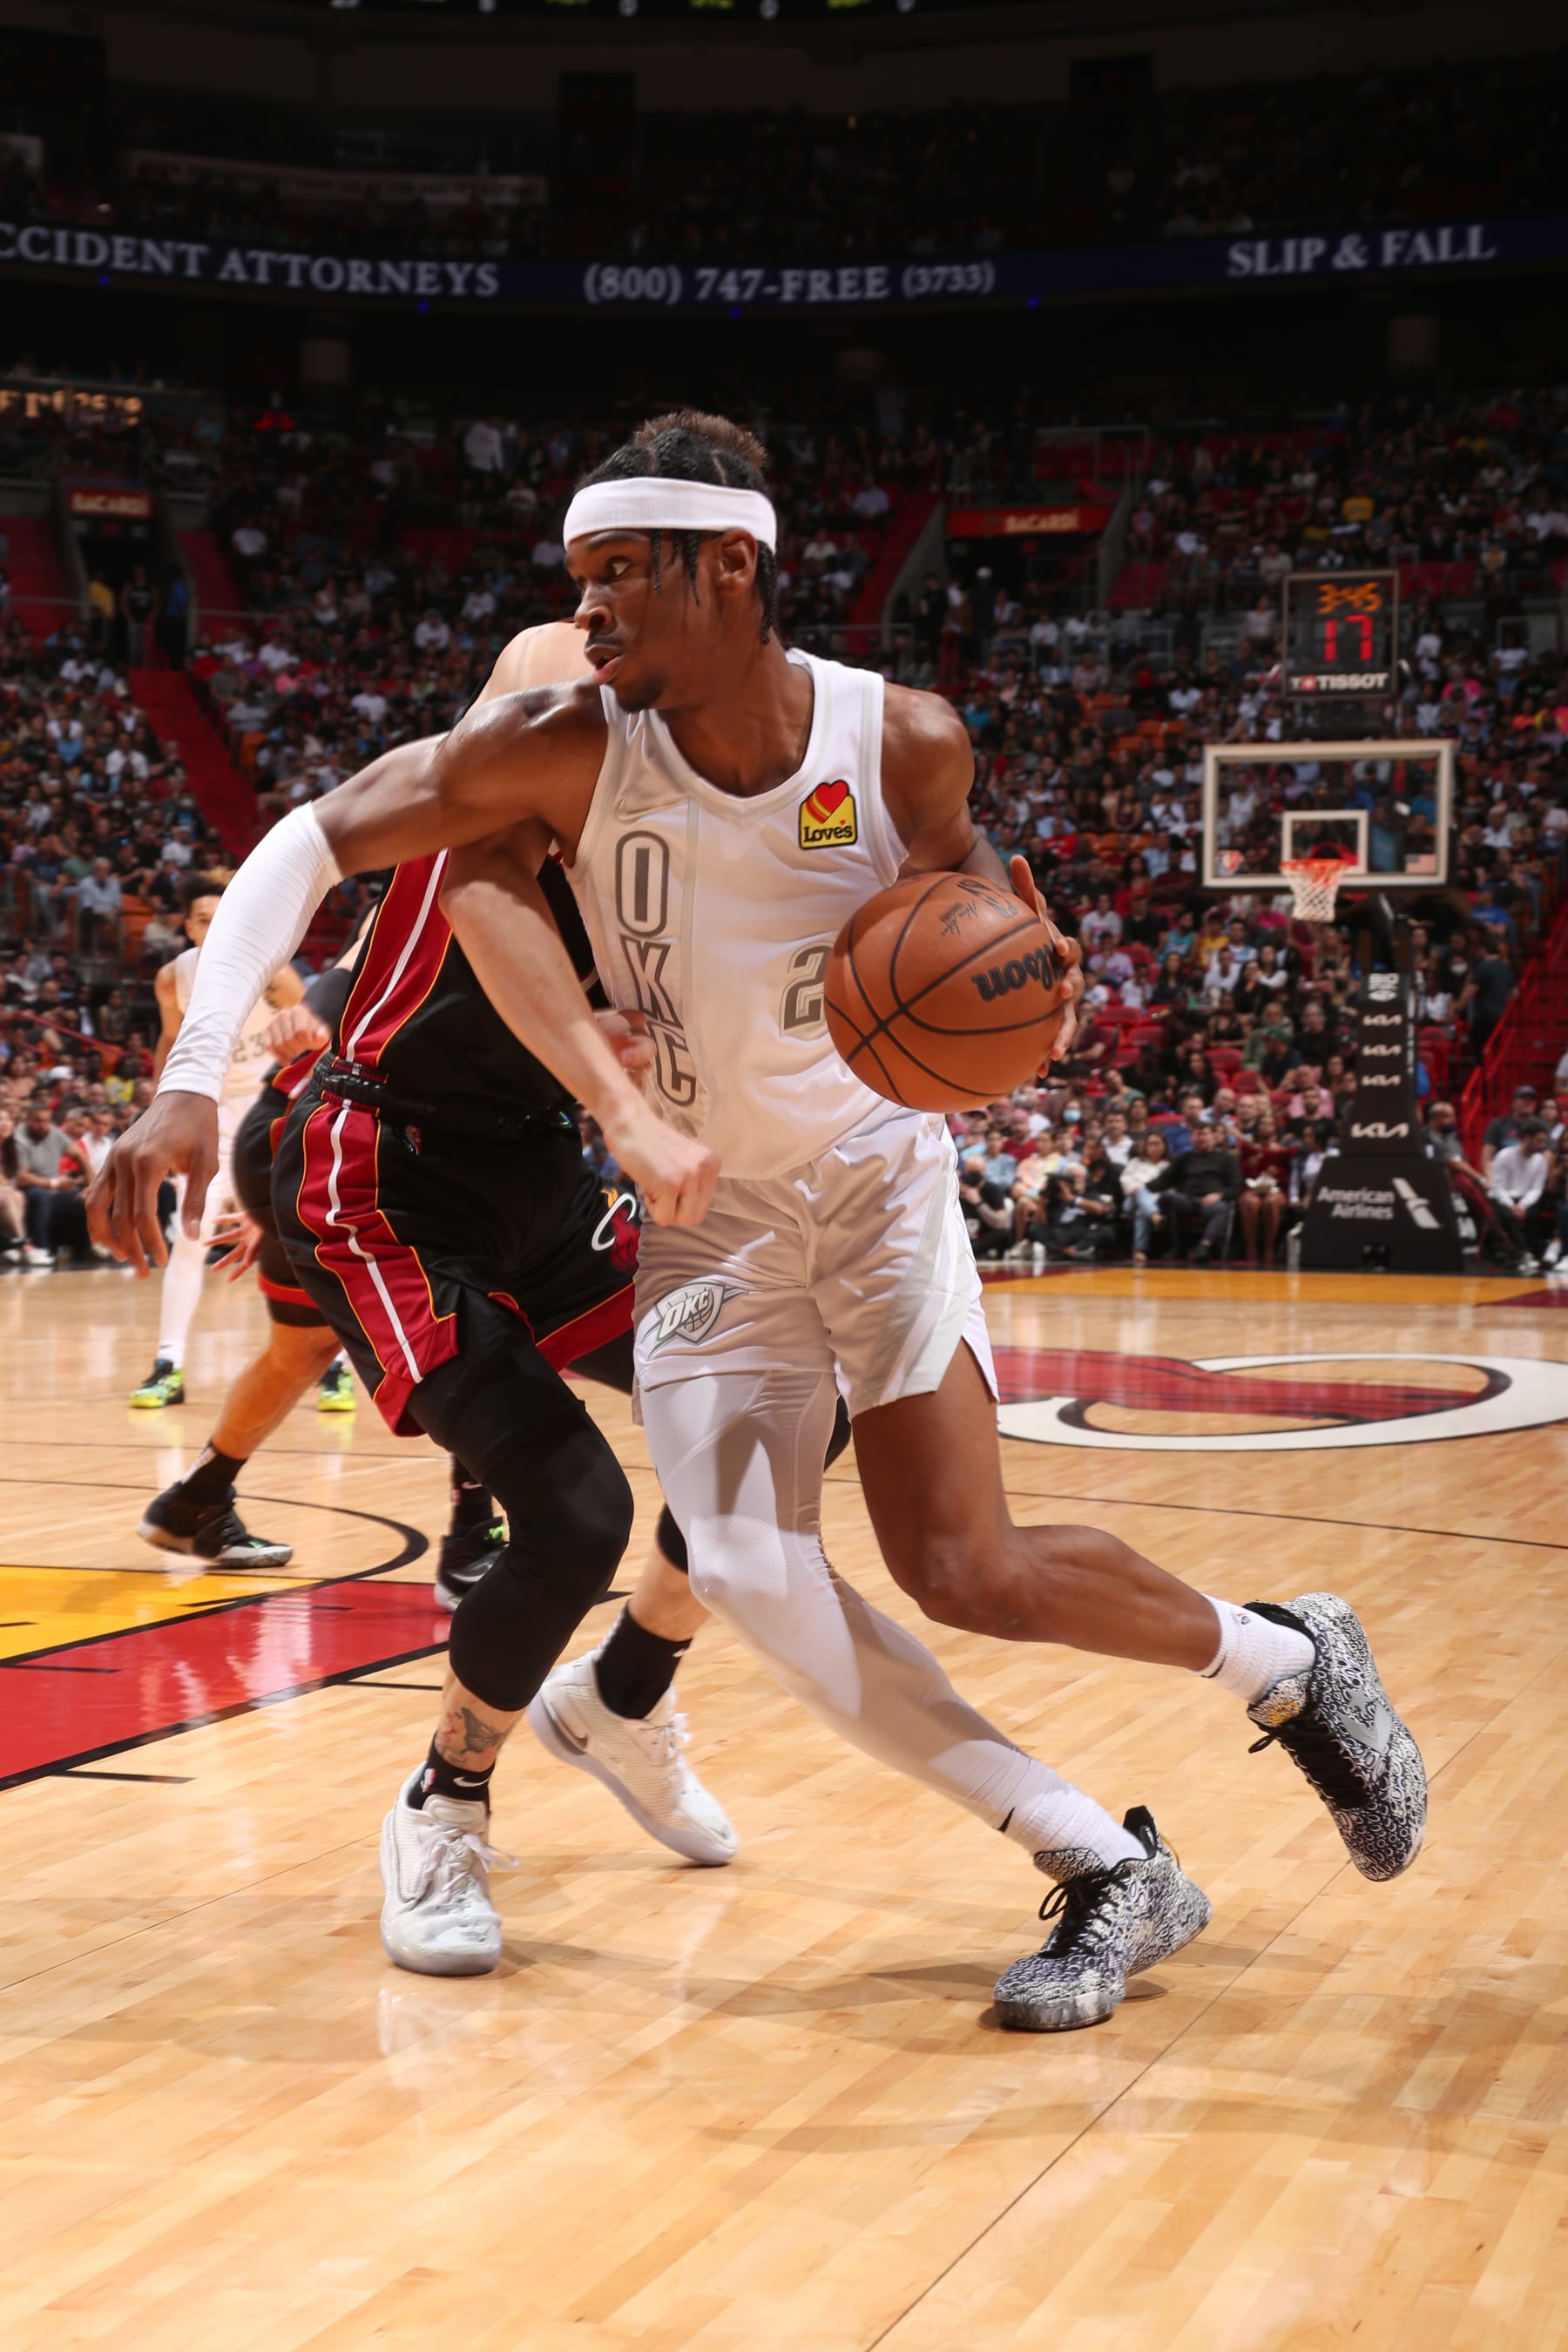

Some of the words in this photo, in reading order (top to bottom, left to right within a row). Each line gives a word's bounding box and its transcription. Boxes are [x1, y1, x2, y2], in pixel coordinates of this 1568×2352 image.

[217, 248, 499, 297] ATTORNEYS
[1227, 238, 1324, 277] SLIP
[1331, 233, 1369, 271] &
[1382, 224, 1497, 267] FALL
[584, 262, 681, 305] (800)
[696, 266, 889, 302] 747-FREE
[902, 261, 996, 298] (3733)
[1325, 614, 1374, 661] 17
[1317, 673, 1388, 691] TISSOT
[233, 1033, 266, 1062] 23
[1316, 1186, 1396, 1205] American
[1331, 1202, 1395, 1220] Airlines
[659, 1290, 710, 1339] OKC
